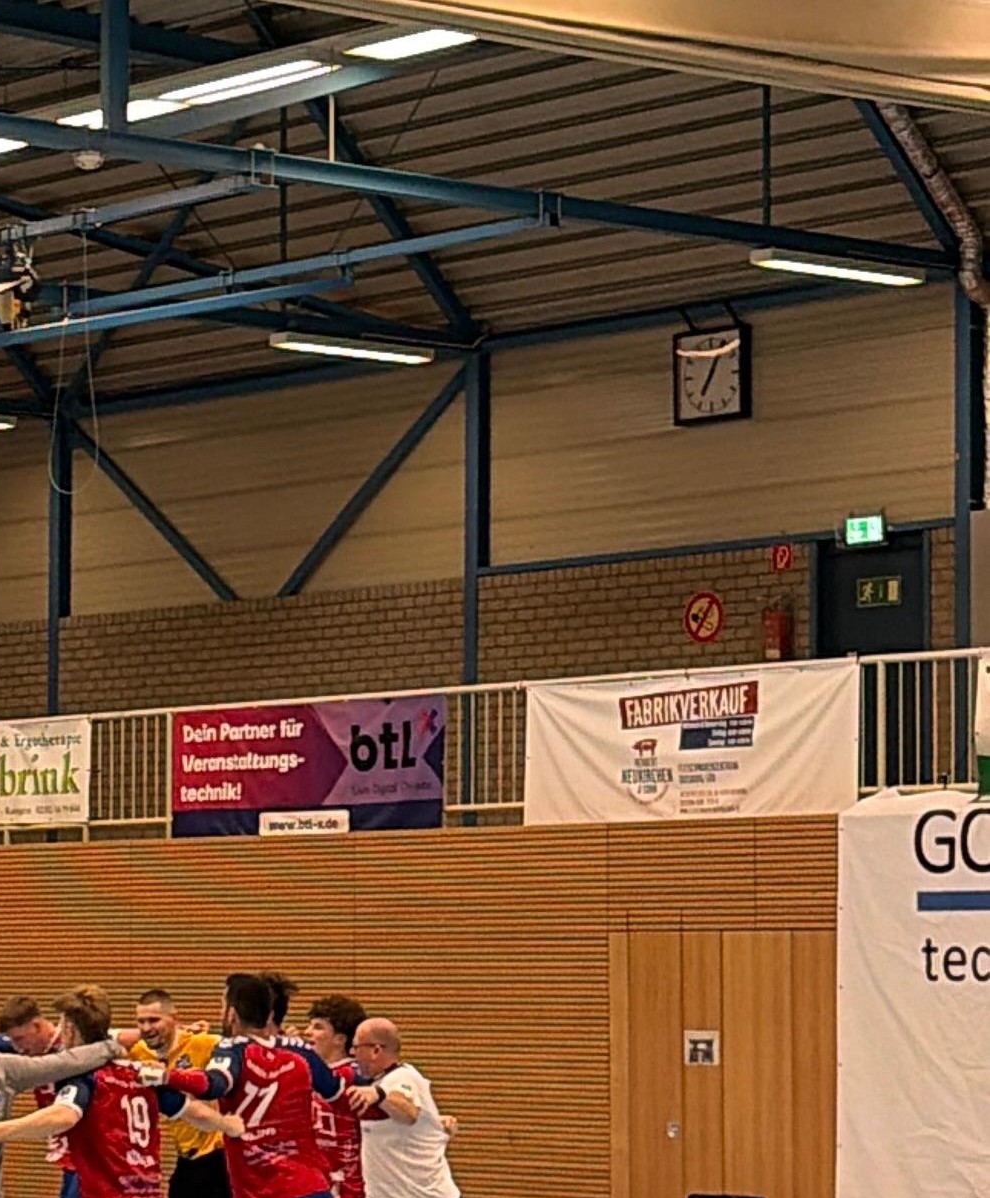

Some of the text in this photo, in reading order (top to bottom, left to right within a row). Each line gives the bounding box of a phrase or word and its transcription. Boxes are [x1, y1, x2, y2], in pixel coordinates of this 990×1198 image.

[625, 684, 750, 728] FABRIKVERKAUF
[183, 718, 304, 743] Dein Partner für
[350, 720, 416, 772] btl
[182, 752, 306, 773] Veranstaltungs-
[180, 781, 242, 802] technik!
[921, 938, 990, 982] tec
[120, 1094, 150, 1149] 19
